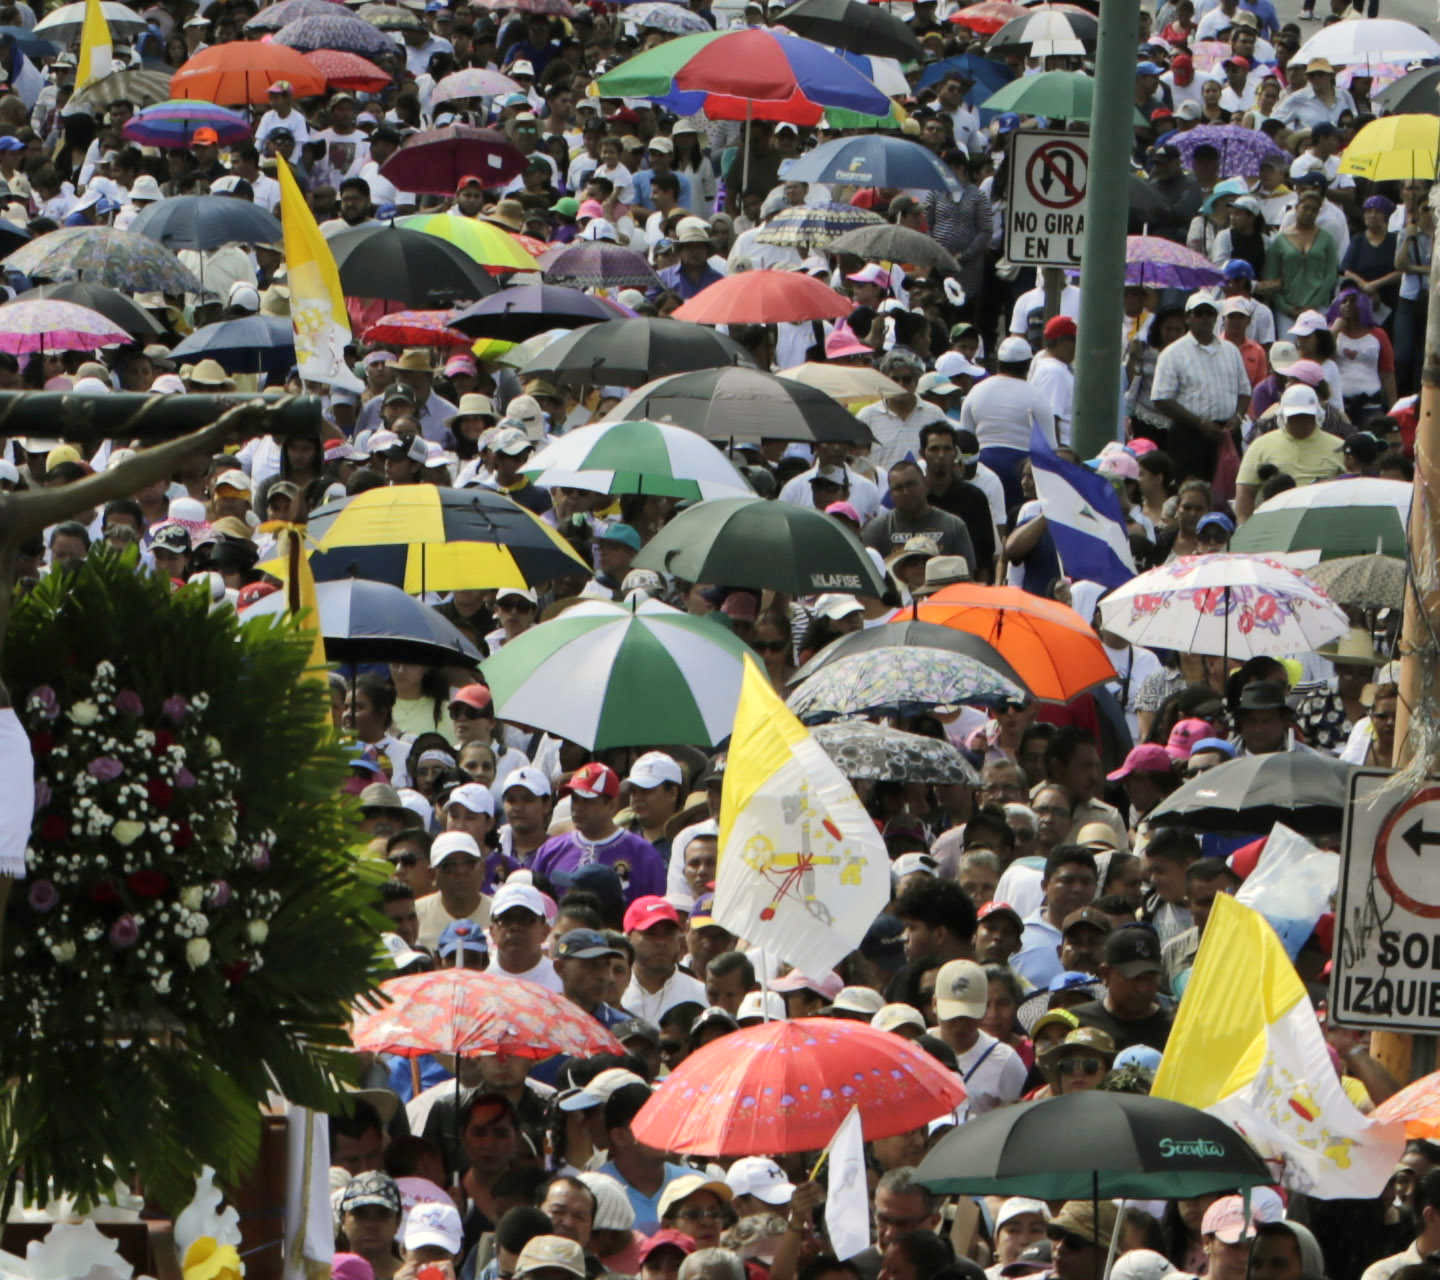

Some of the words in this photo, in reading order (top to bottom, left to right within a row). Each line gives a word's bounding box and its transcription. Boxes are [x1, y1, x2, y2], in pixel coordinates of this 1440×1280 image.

[1014, 212, 1038, 232] NO
[1045, 213, 1085, 235] GIRA
[1025, 237, 1049, 258] EN
